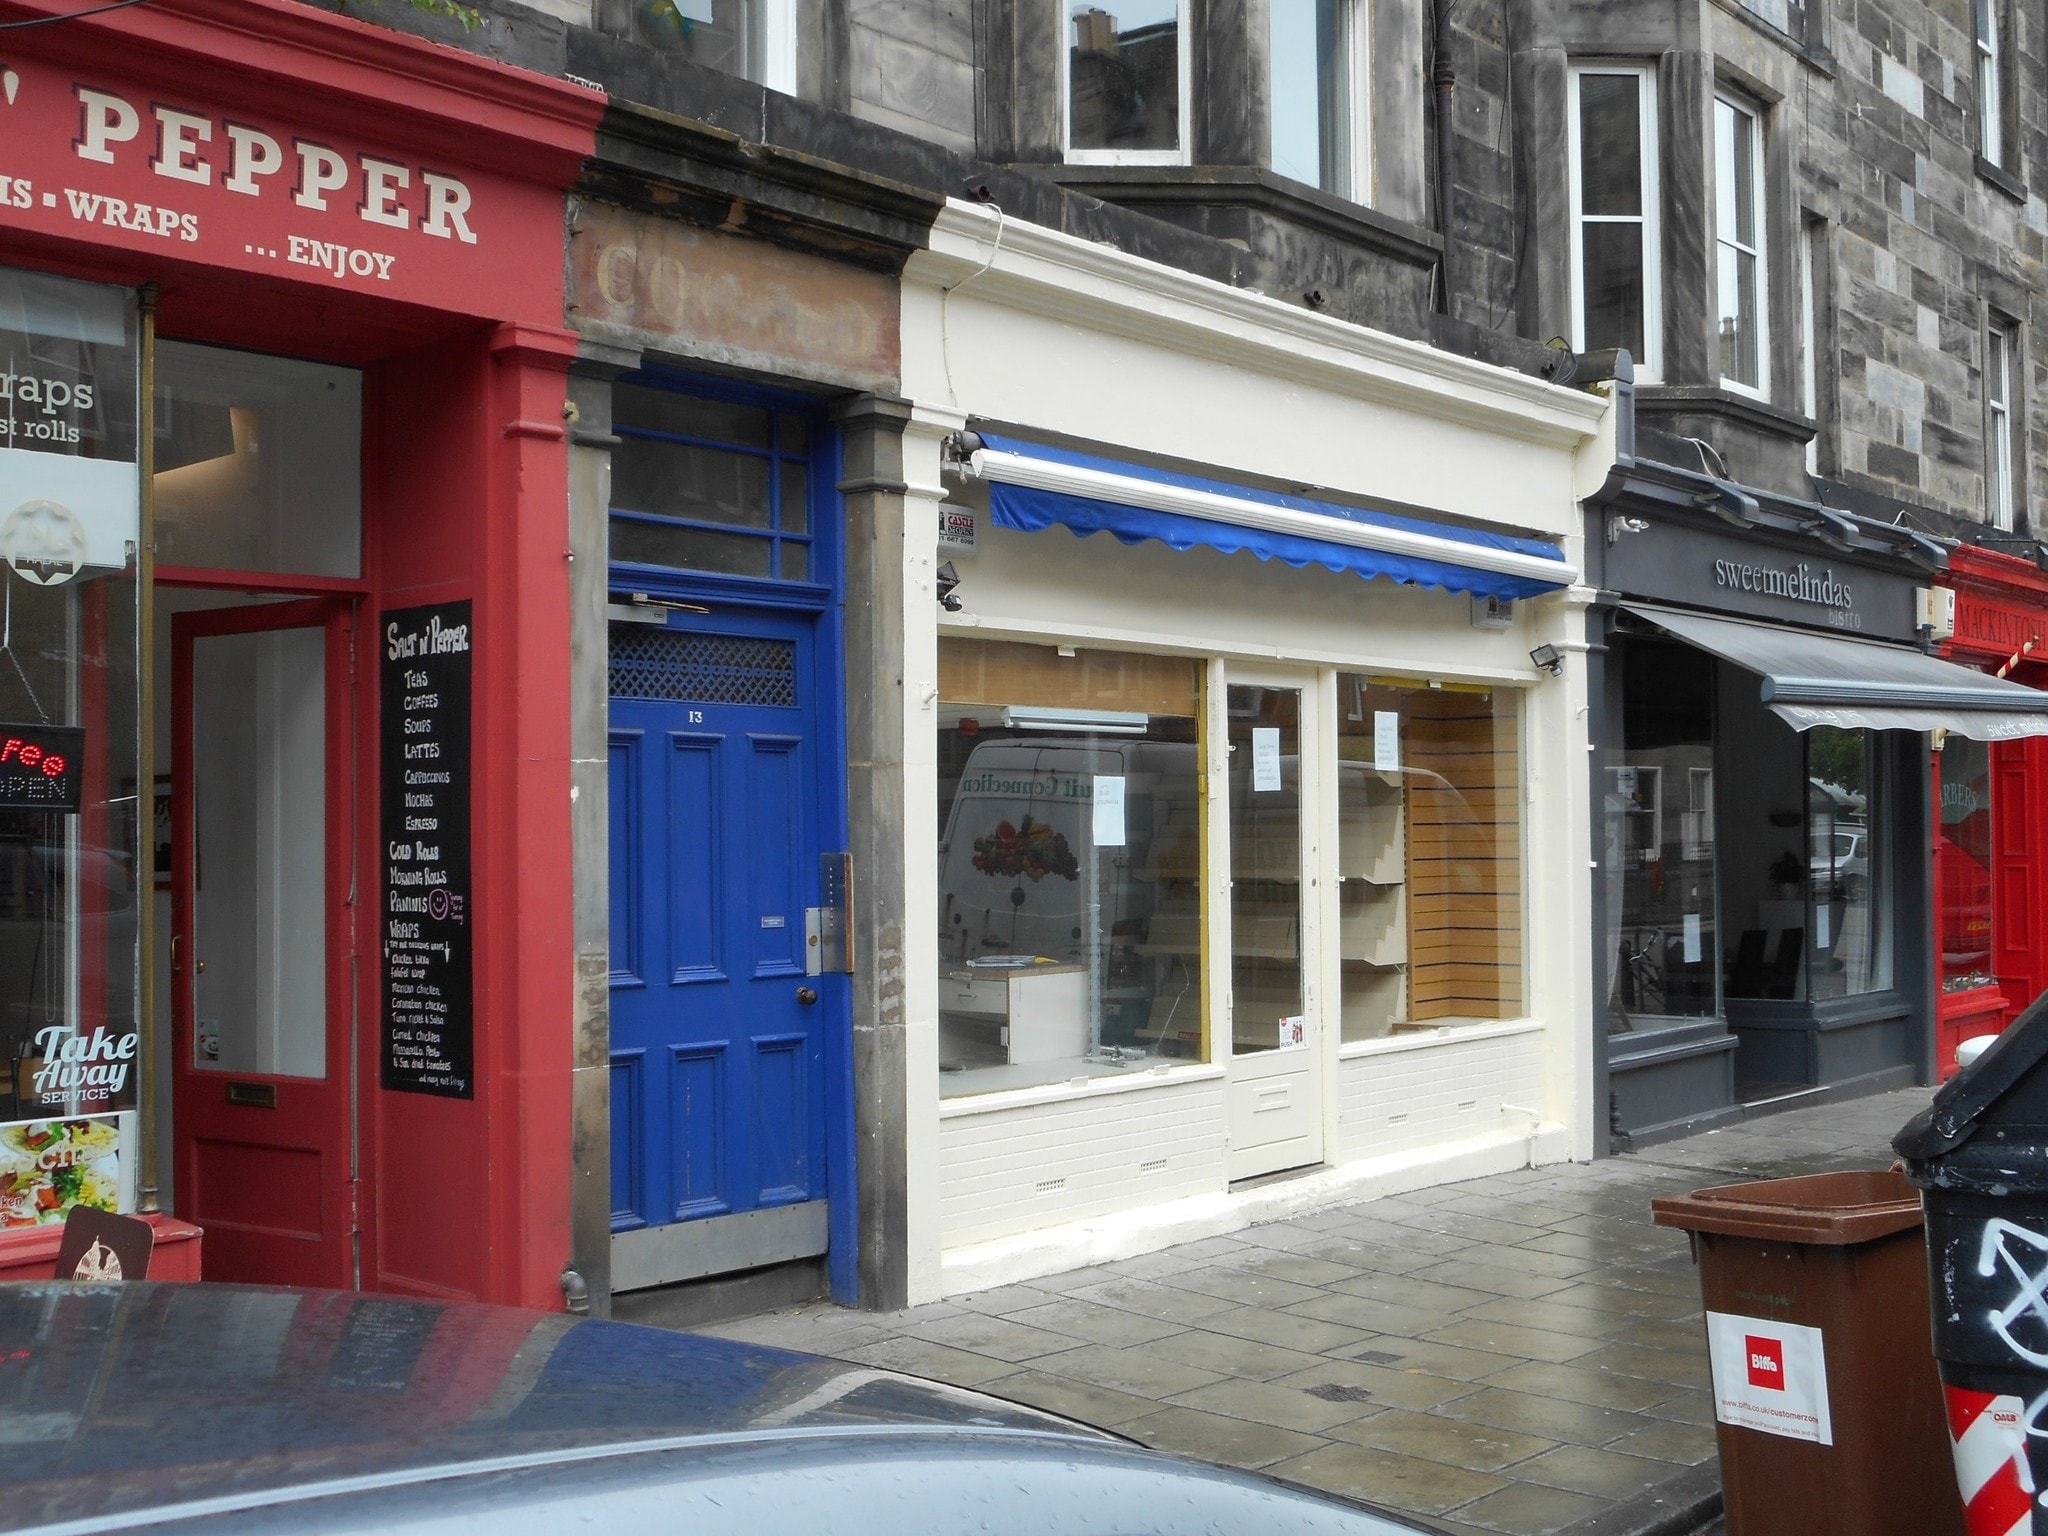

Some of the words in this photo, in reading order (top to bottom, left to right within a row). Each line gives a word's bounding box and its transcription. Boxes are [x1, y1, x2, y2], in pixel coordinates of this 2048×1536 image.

[75, 86, 478, 245] PEPPER
[64, 188, 199, 242] WRAPS
[287, 234, 396, 280] ENJOY
[0, 371, 94, 415] raps
[24, 420, 80, 443] rolls
[948, 516, 974, 528] CASTLE
[1715, 558, 1852, 609] sweetmelindas
[1829, 608, 1861, 629] bistro
[689, 711, 703, 723] 13
[404, 742, 440, 759] LATTES
[1940, 783, 1977, 812] RBERS
[389, 919, 420, 938] WRAPS
[35, 1026, 138, 1064] Take
[32, 1060, 128, 1093] Away
[41, 1088, 109, 1104] SERVICE
[1751, 1353, 1778, 1372] Biffa
